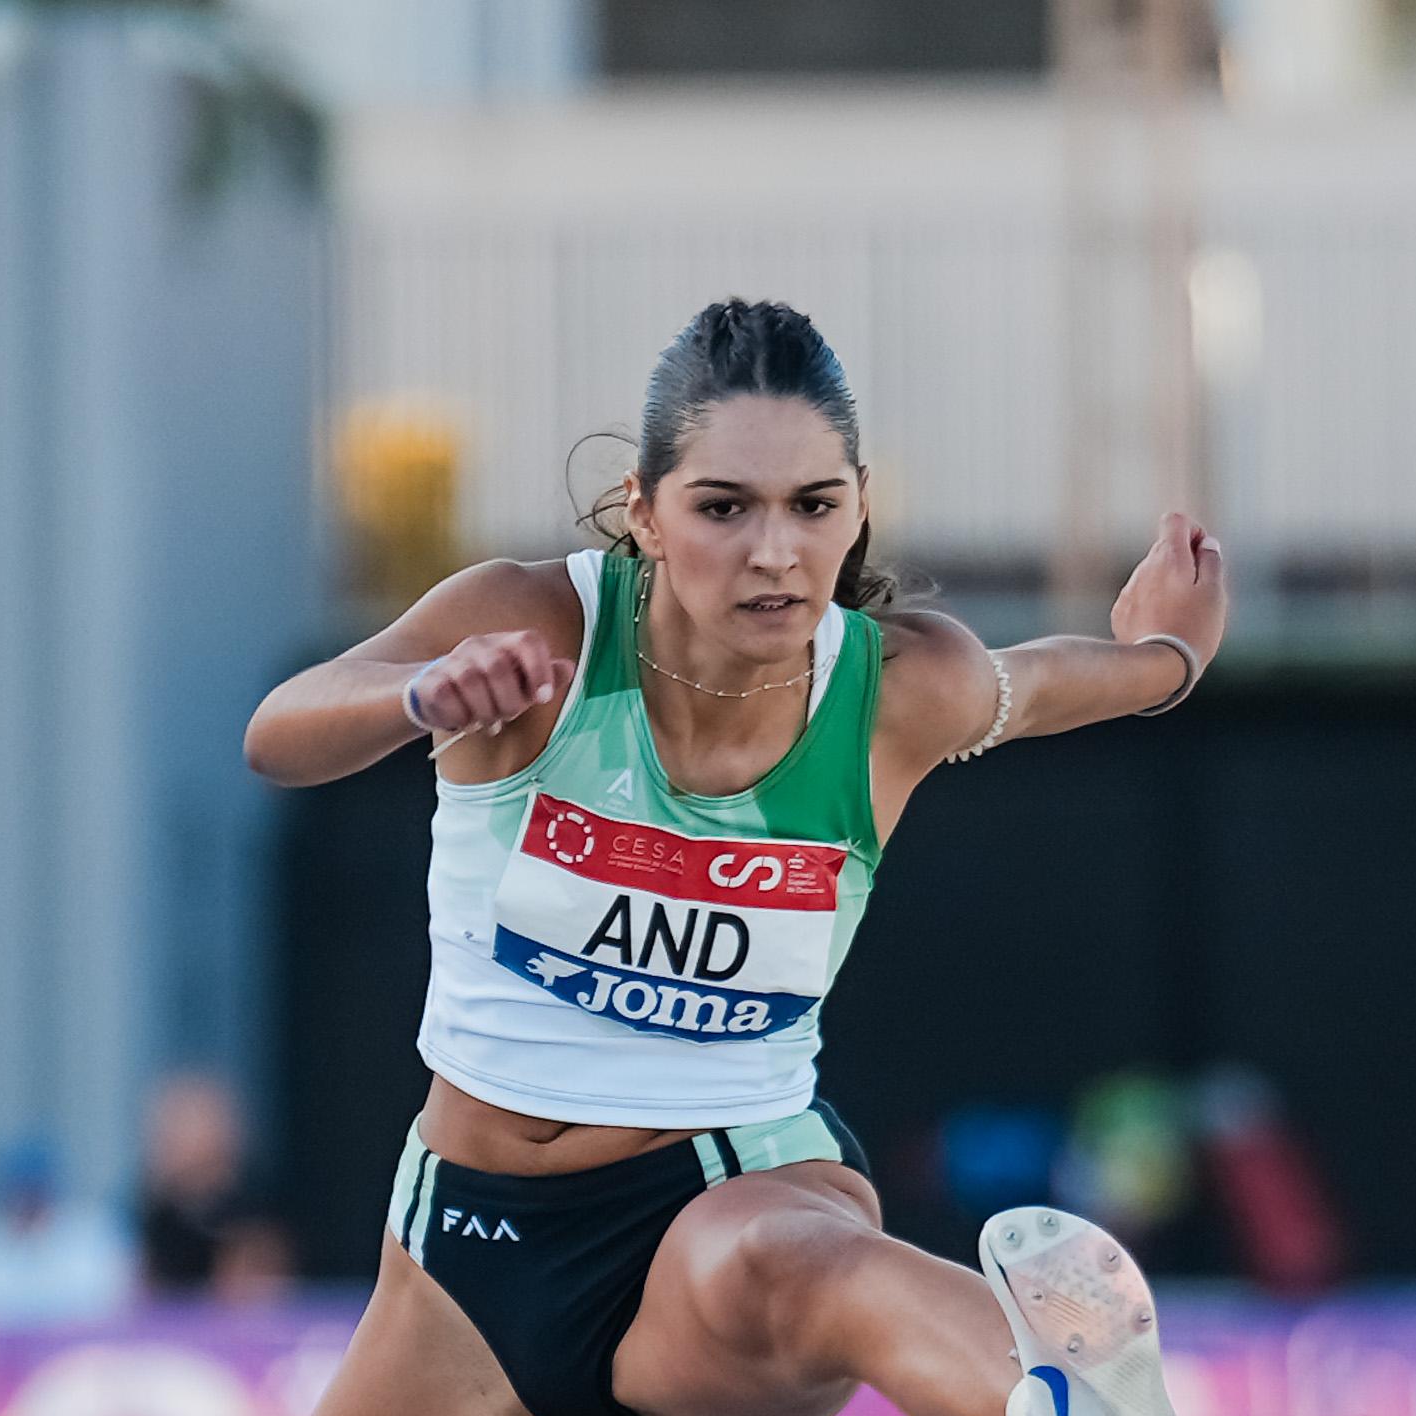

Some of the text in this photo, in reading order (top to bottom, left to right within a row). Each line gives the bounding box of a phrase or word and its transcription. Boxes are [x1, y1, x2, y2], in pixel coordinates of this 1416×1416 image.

[612, 835, 684, 867] CESA
[581, 894, 750, 981] AND
[442, 1208, 520, 1242] FAA
